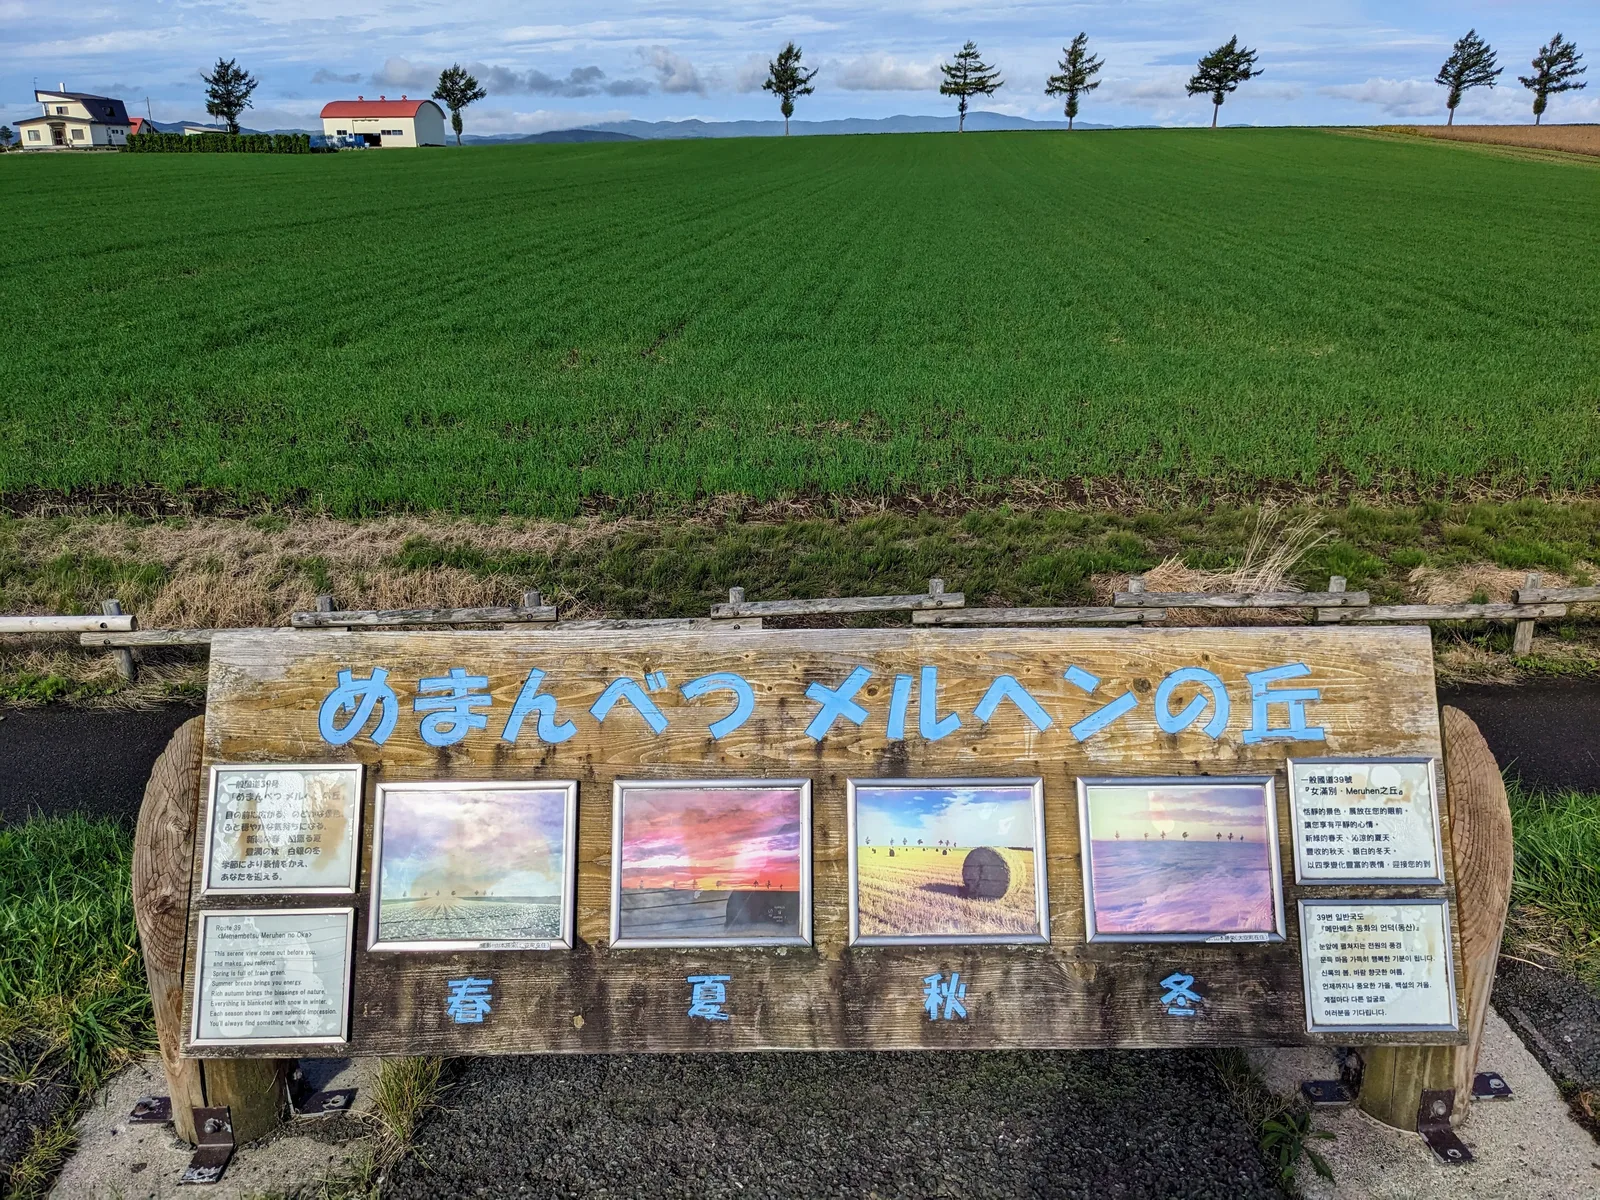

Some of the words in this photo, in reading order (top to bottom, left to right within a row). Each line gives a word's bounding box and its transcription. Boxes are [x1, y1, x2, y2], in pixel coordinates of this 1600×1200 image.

[318, 666, 756, 747] めまんべつ
[804, 662, 1326, 744] メルヘンの丘
[1301, 776, 1352, 784] 一般國道39號
[1317, 913, 1333, 921] 39번
[1336, 912, 1364, 921] 일반국도
[1356, 924, 1377, 932] 동화의
[1368, 942, 1387, 950] 전원의
[1389, 941, 1402, 949] 풍경
[1350, 955, 1369, 963] 가득히
[213, 970, 230, 978] Spring
[254, 980, 270, 988] brings
[1323, 982, 1354, 990] 언제까지나
[1395, 981, 1414, 989] 백설의
[246, 990, 263, 998] brings
[687, 975, 730, 1020] 夏
[923, 972, 967, 1020] 秋
[1160, 972, 1202, 1016] 冬
[447, 977, 493, 1023] 春
[1366, 995, 1386, 1003] 얼굴로
[1324, 1009, 1350, 1017] 여러분을
[224, 1020, 243, 1028] always
[257, 1019, 284, 1027] something
